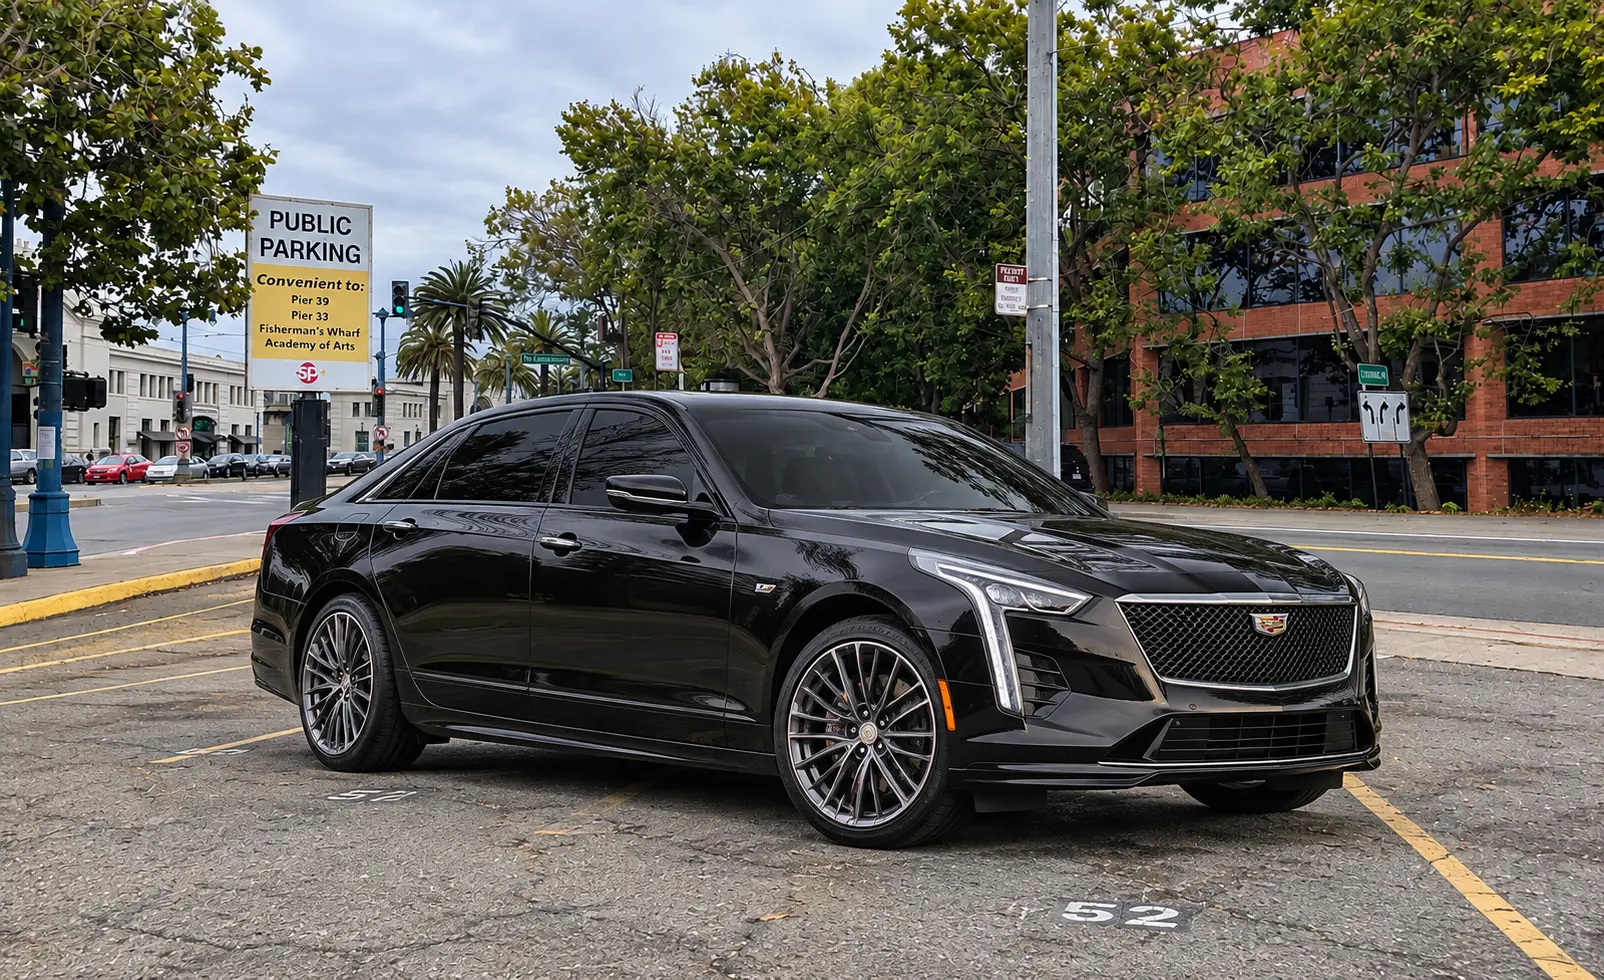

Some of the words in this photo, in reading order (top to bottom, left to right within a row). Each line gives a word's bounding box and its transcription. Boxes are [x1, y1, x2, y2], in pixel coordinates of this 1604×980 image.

[270, 210, 352, 236] PUBLIC
[260, 237, 361, 264] PARKING
[256, 273, 342, 290] Convenient
[345, 279, 365, 292] to:
[291, 295, 313, 306] Pier
[316, 296, 330, 306] 39
[291, 310, 313, 321] Pier
[316, 311, 329, 321] 33
[259, 324, 324, 336] Fisherman's
[327, 327, 361, 338] Wharf
[265, 338, 316, 351] Academy
[319, 340, 331, 350] of
[333, 341, 355, 351] Arts
[1061, 901, 1180, 928] 52
